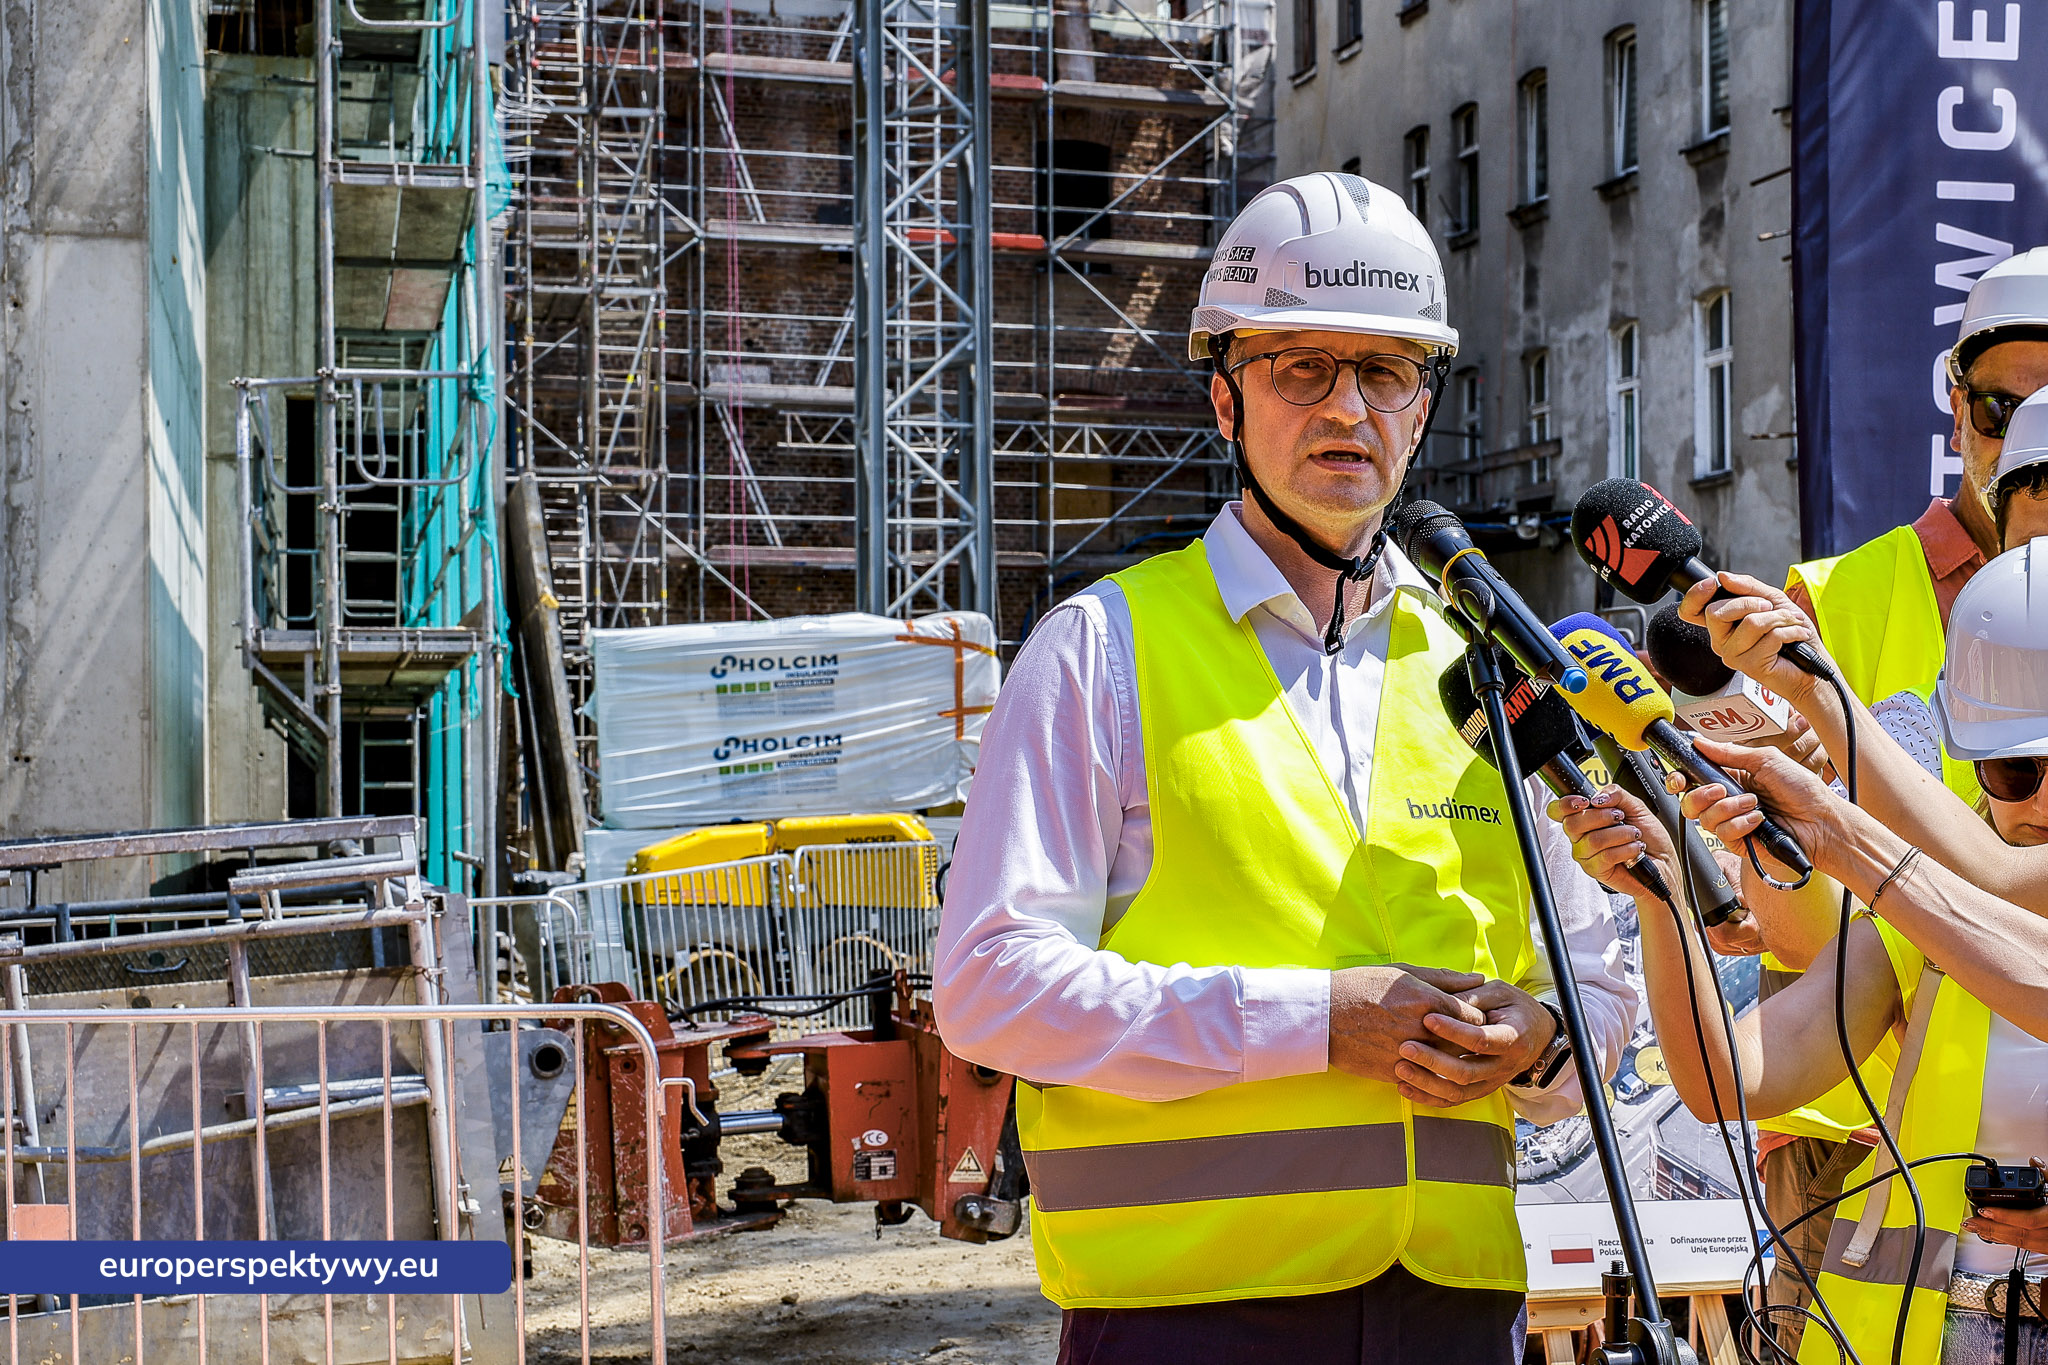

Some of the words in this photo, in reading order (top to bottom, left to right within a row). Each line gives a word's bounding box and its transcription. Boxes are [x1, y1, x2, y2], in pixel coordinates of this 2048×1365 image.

[1228, 247, 1253, 261] SAFE
[1931, 0, 2021, 497] TWICE
[1223, 267, 1256, 282] READY
[1304, 259, 1420, 293] budimex
[1622, 499, 1654, 529] RADIO
[1623, 503, 1671, 548] KATOWICE
[740, 654, 839, 671] HOLCIM
[1567, 639, 1655, 705] RMF
[1689, 711, 1711, 719] RADIO
[1458, 708, 1488, 746] RADIO
[743, 734, 842, 753] HOLCIM
[1406, 796, 1502, 825] budimex
[1670, 1235, 1726, 1245] Dofinansowane
[1727, 1235, 1747, 1245] przez
[1691, 1245, 1708, 1254] Unię
[1709, 1244, 1749, 1254] Europejską
[1600, 1247, 1623, 1256] Polska
